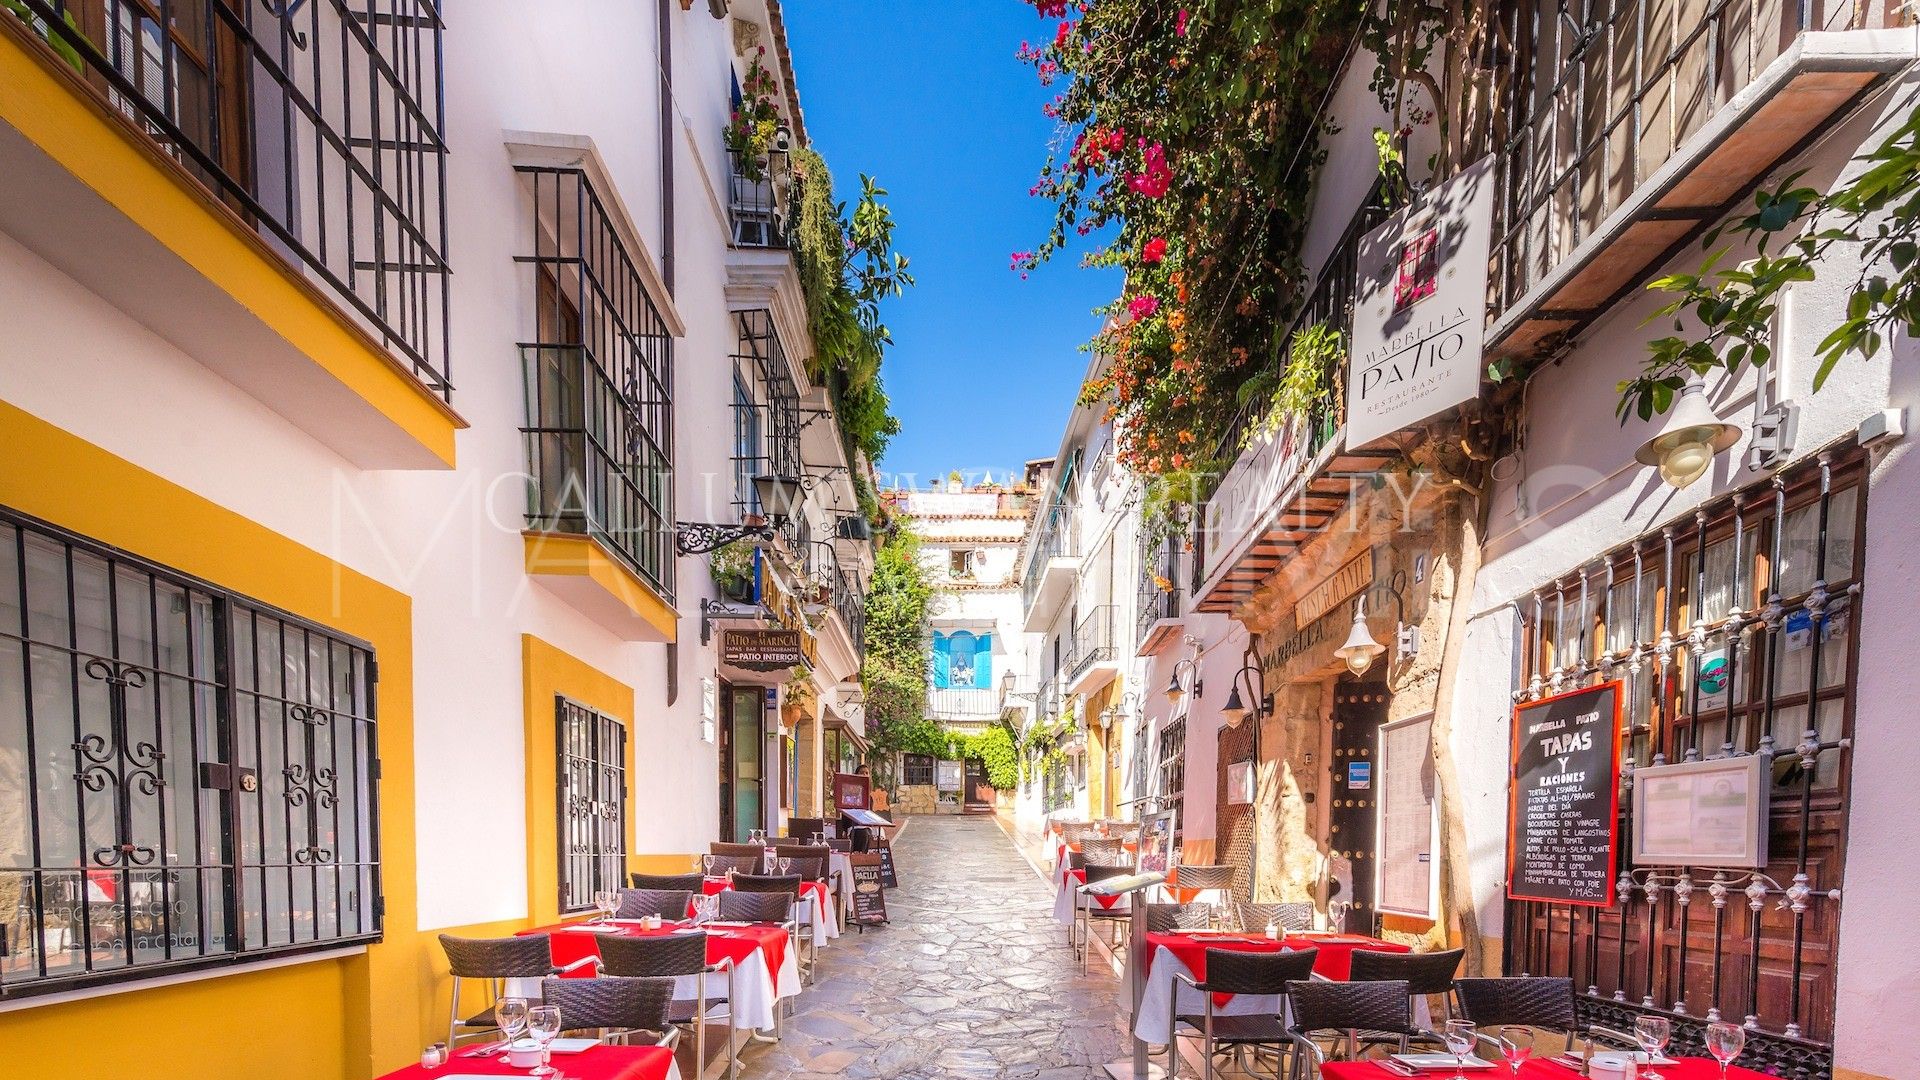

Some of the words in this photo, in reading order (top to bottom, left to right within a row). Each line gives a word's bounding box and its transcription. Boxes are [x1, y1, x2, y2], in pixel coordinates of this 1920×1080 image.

[1364, 307, 1465, 366] MARBELLA
[1361, 333, 1463, 401] PATIO
[1366, 368, 1453, 414] RESTAURANTE
[1385, 400, 1408, 414] Desde
[1414, 554, 1425, 584] 4
[726, 632, 750, 646] PATIO
[759, 633, 798, 647] MARISCAL
[1263, 618, 1324, 674] MARBELLA
[1529, 718, 1566, 735] MARBELLA
[1575, 711, 1600, 725] PATIO
[1540, 730, 1593, 758] TAPAS
[1558, 756, 1569, 774] Y
[1540, 771, 1586, 787] RACIONES
[854, 871, 879, 881] PAELLA
[1568, 887, 1574, 897] Y
